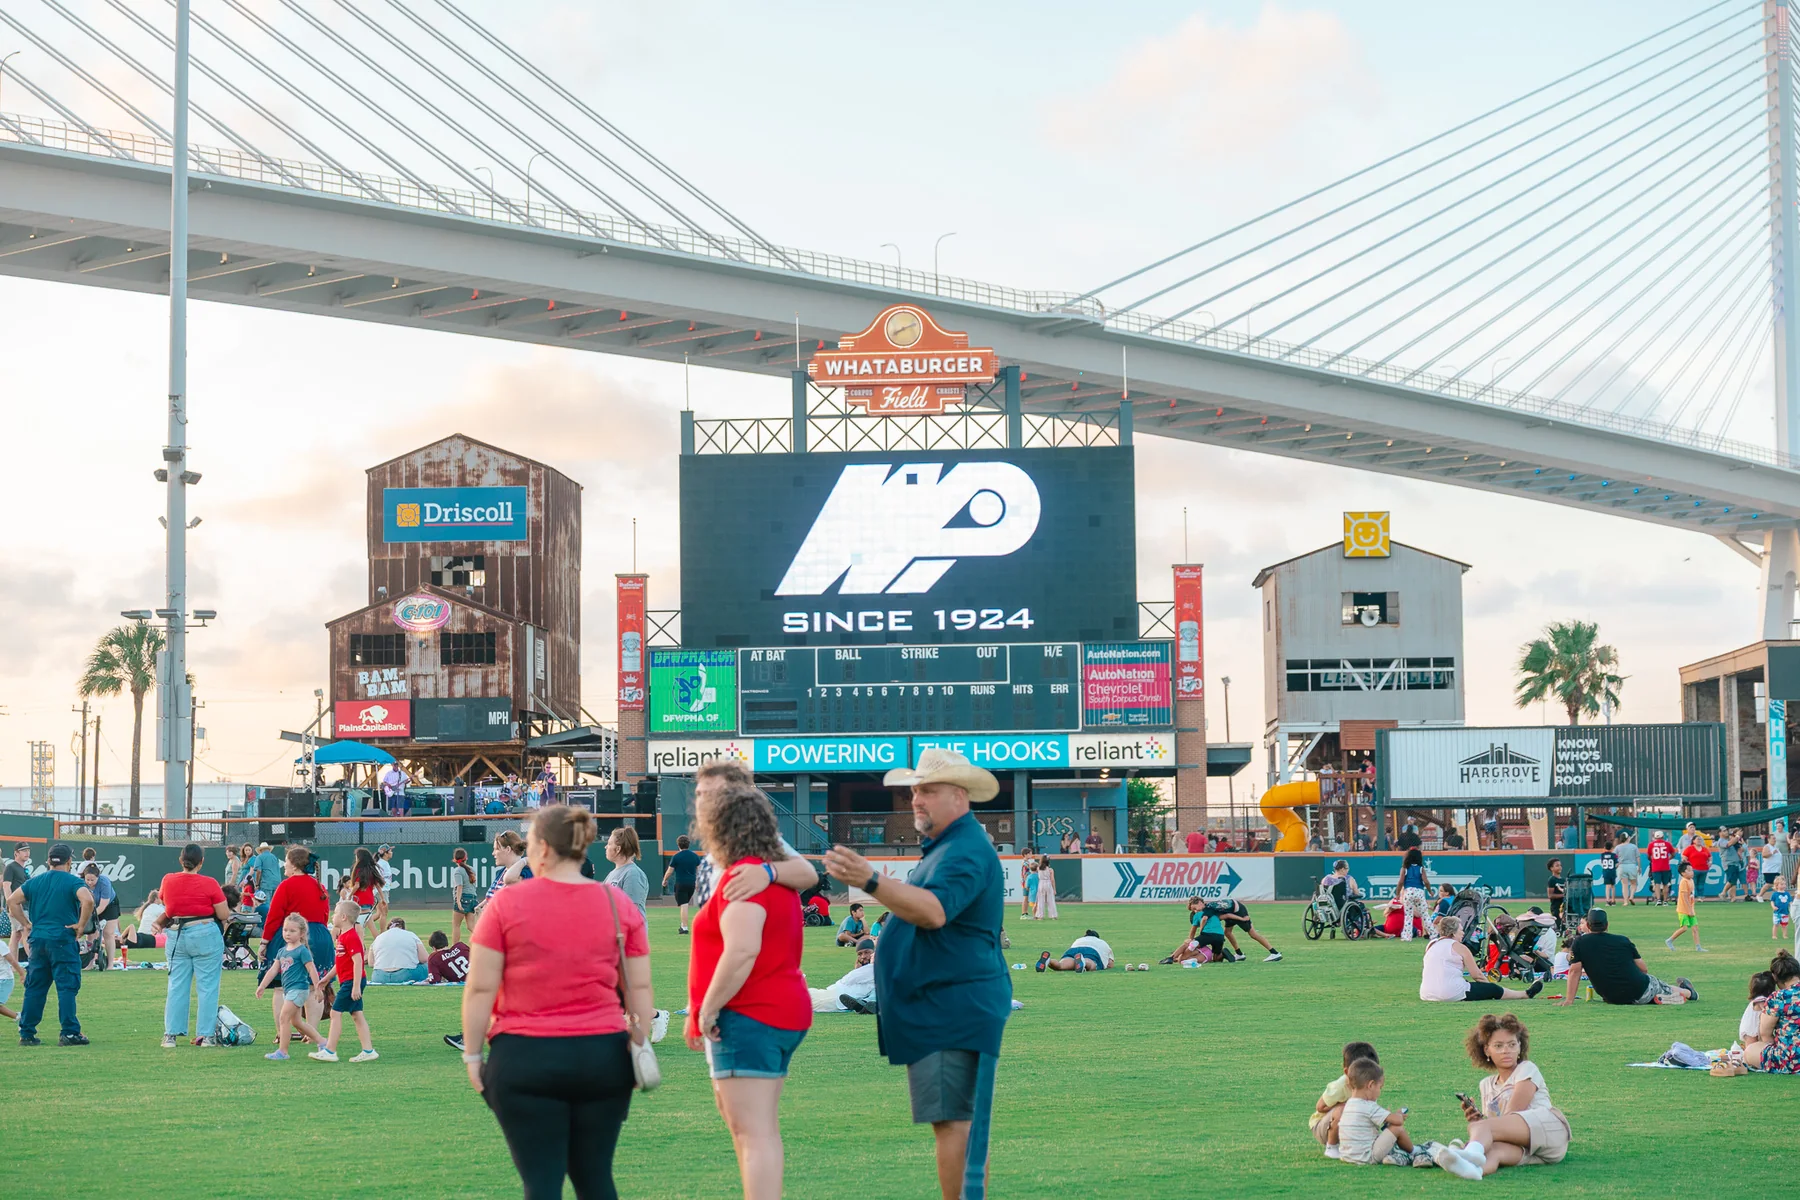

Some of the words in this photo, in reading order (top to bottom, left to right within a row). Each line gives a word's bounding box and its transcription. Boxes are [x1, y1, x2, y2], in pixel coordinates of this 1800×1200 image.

[824, 356, 983, 376] WHATABURGER
[850, 388, 873, 396] CORPUS
[879, 385, 930, 409] Field
[936, 387, 960, 395] CHRISTI
[423, 501, 514, 522] Driscoll
[782, 610, 913, 633] SINCE
[933, 608, 1035, 631] 1924
[750, 649, 764, 662] AT
[766, 649, 786, 661] BAT
[835, 649, 862, 661] BALL
[901, 647, 939, 659] STRIKE
[976, 646, 998, 658] OUT
[1044, 645, 1063, 657] H/E
[1087, 650, 1161, 659] AutoNation.com
[1089, 668, 1155, 680] AutoNation
[366, 680, 407, 697] BAM
[807, 687, 812, 697] 1
[821, 687, 827, 697] 2
[835, 686, 842, 697] 3
[852, 686, 859, 696] 4
[866, 686, 873, 696] 5
[881, 686, 888, 696] 6
[898, 686, 905, 696] 7
[912, 686, 919, 696] 8
[927, 686, 934, 695] 9
[941, 685, 954, 695] 10
[970, 684, 995, 695] RUNS
[1012, 684, 1033, 695] HITS
[1050, 684, 1069, 694] ERR
[1088, 683, 1143, 694] Chevrolet
[488, 711, 509, 725] MPH
[1557, 738, 1598, 749] KNOW
[653, 746, 722, 767] reliant
[767, 743, 895, 765] POWERING
[973, 740, 1061, 762] HOOKS
[1075, 740, 1144, 761] reliant
[1556, 750, 1600, 761] WHO'S
[1555, 763, 1577, 773] ON
[1578, 762, 1613, 773] YOUR
[1771, 719, 1787, 820] HOOK
[1460, 766, 1541, 784] HARGROVE
[1555, 775, 1591, 785] ROOF
[1652, 846, 1668, 860] 85
[1602, 858, 1614, 870] 99
[1143, 861, 1224, 885] ARROW
[1139, 886, 1222, 899] EXTERMINATORS
[447, 955, 471, 979] 12
